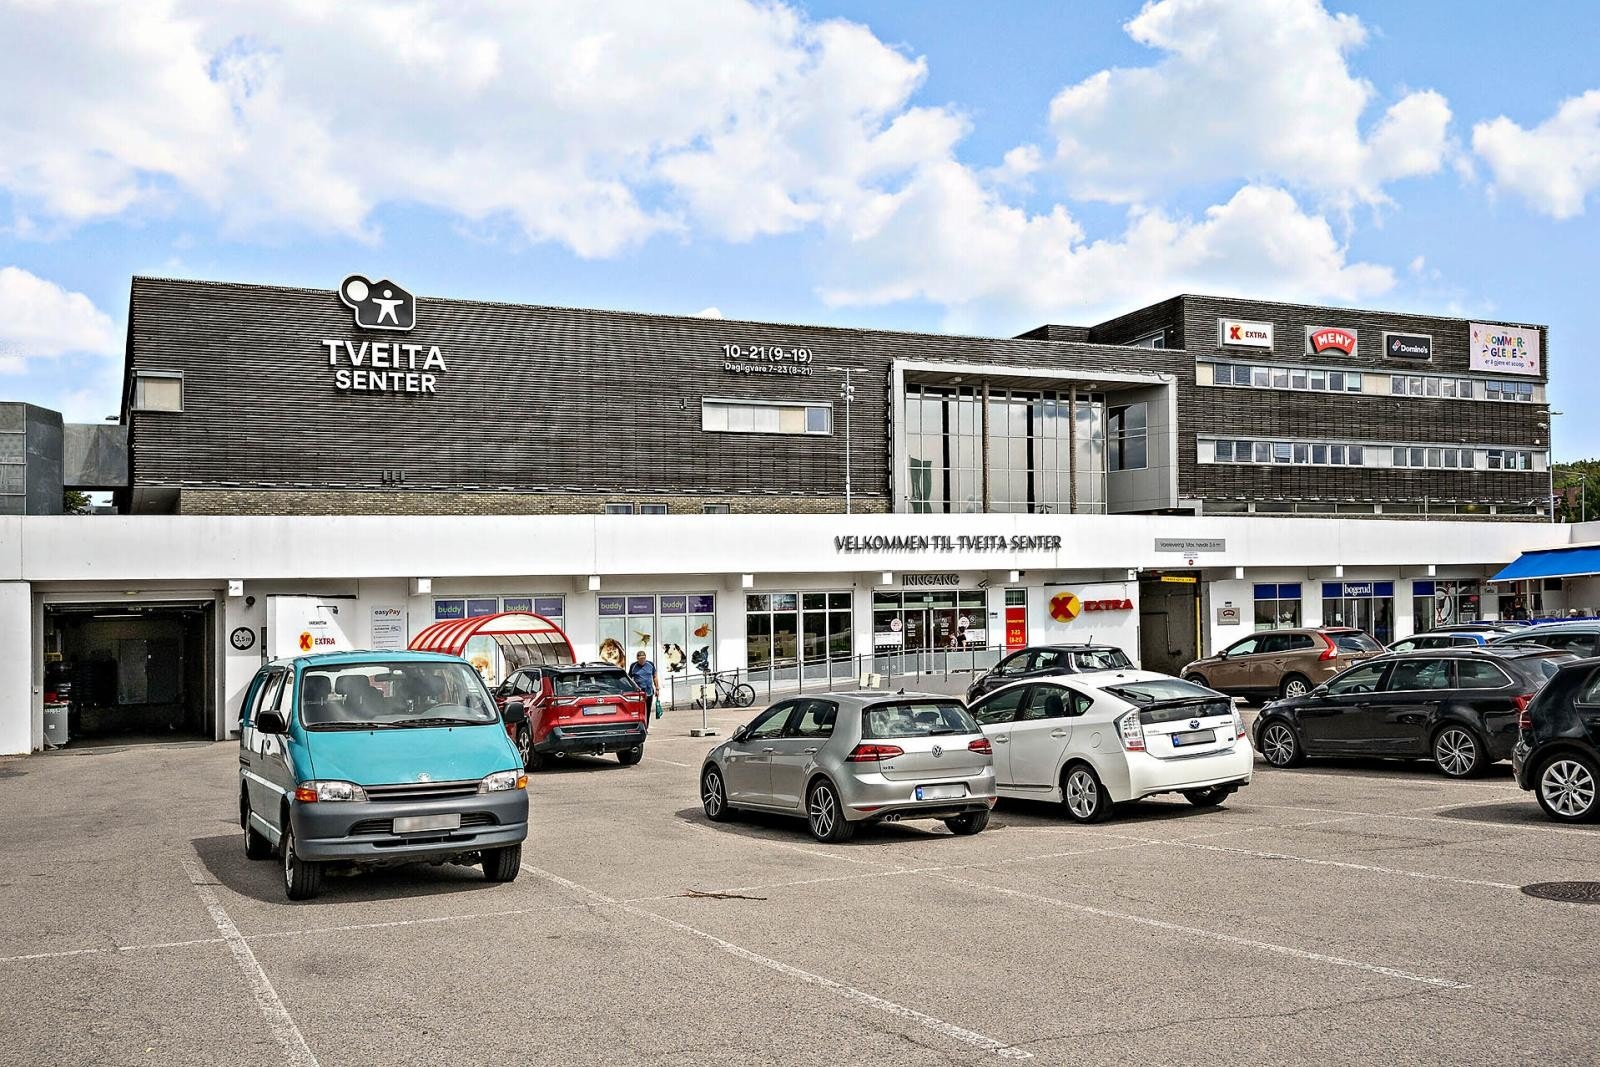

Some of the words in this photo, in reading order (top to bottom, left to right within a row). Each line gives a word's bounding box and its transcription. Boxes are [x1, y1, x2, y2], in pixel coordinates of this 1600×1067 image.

[1245, 331, 1267, 339] EXTRA
[1317, 333, 1351, 347] MENY
[322, 339, 447, 371] TVEITA
[723, 344, 765, 359] 10-21
[768, 346, 813, 363] (9-19)
[1400, 345, 1428, 354] Domino's
[1491, 347, 1517, 358] GLEDE
[725, 362, 767, 373] Dagligvare
[768, 365, 788, 374] 7-23
[788, 366, 813, 375] (8-21)
[335, 370, 437, 393] SENTER
[834, 535, 929, 552] VELKOMMEN
[932, 535, 955, 551] TIL
[957, 535, 1008, 551] TVEITA
[1009, 535, 1062, 551] SENTER
[902, 573, 960, 586] INNGANG
[1344, 583, 1371, 597] bogerud
[437, 605, 462, 614] buddy
[506, 604, 529, 612] buddy
[600, 601, 623, 611] buddy
[662, 600, 684, 609] buddy
[1083, 599, 1133, 611] EXTRA
[374, 608, 401, 616] easyPay
[314, 637, 336, 645] EXTRA
